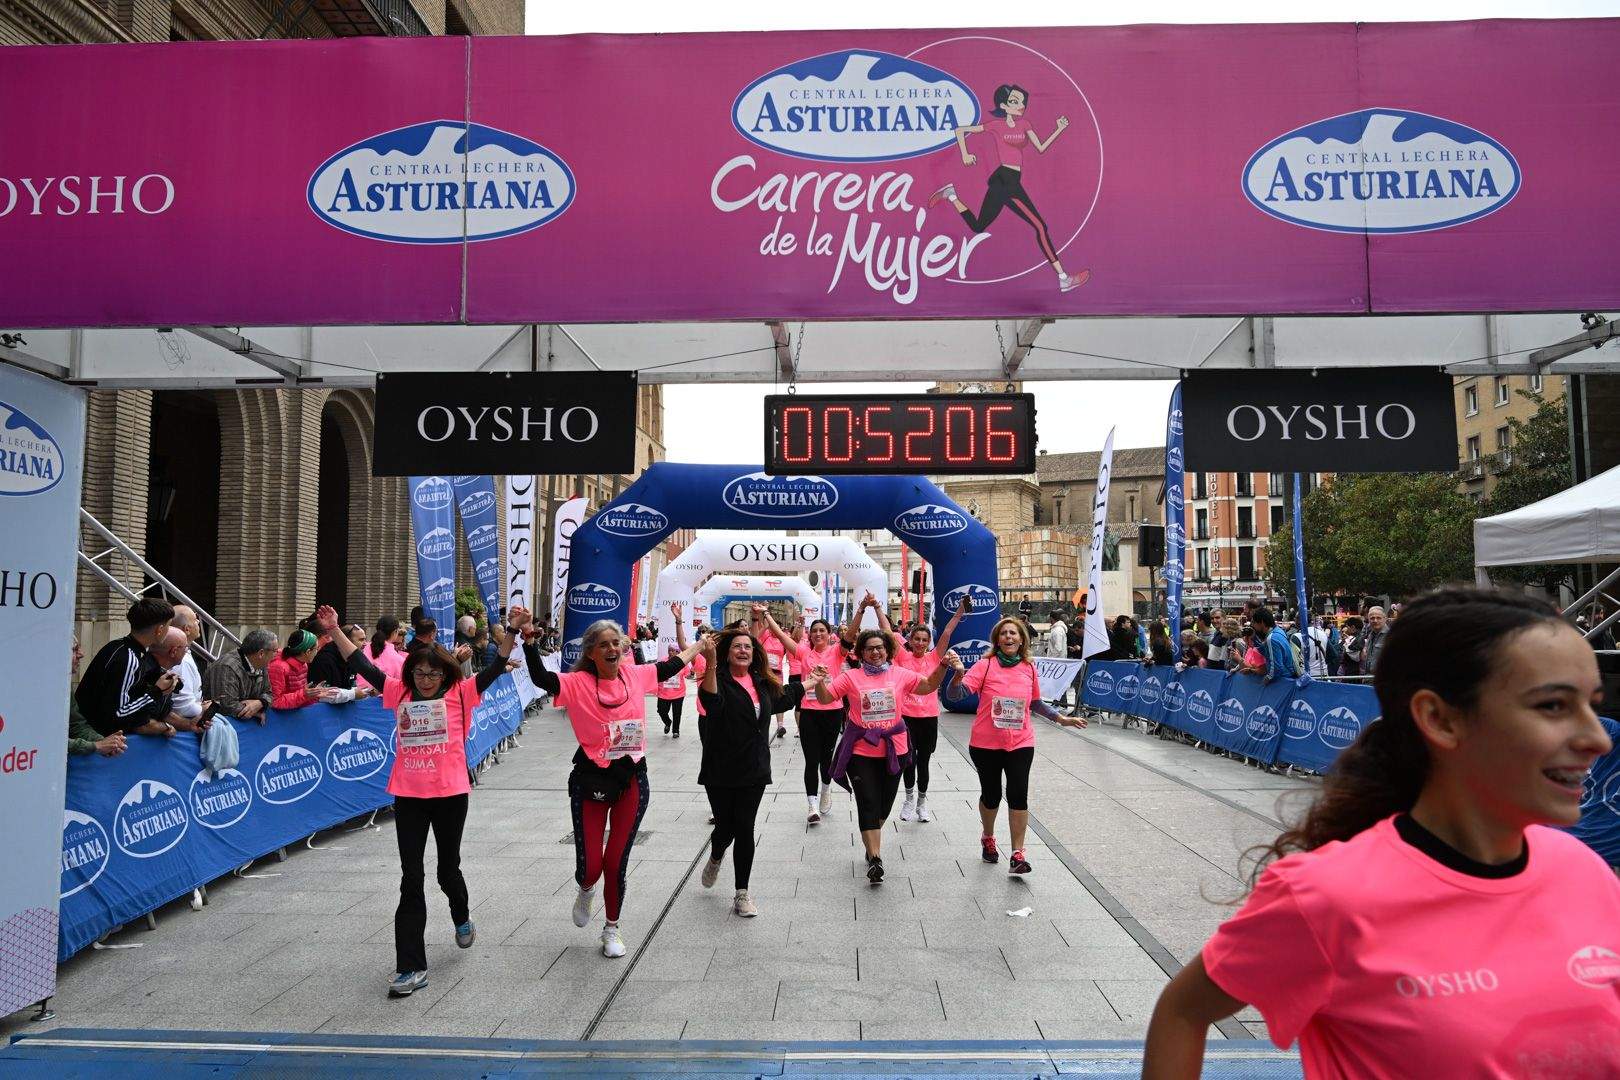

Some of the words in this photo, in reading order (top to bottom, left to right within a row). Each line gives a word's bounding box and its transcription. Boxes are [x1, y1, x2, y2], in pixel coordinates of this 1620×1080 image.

[790, 88, 866, 100] CENTRAL
[874, 88, 953, 99] LECHERA
[751, 91, 958, 132] ASTURIANA
[370, 162, 451, 176] CENTRAL
[461, 160, 547, 174] LECHERA
[1306, 151, 1391, 165] CENTRAL
[1401, 149, 1490, 163] LECHERA
[327, 166, 555, 214] ASTURIANA
[710, 155, 913, 214] Carrera
[1264, 156, 1501, 202] ASTURIANA
[759, 217, 797, 256] de
[807, 214, 833, 257] la
[828, 207, 991, 305] Mujer
[417, 405, 599, 443] OYSHO
[1226, 403, 1417, 442] OYSHO
[0, 448, 54, 480] RIANA
[731, 485, 831, 506] ASTURIANA
[600, 511, 663, 529] ASTURIANA
[900, 517, 963, 531] ASTURIANA
[729, 543, 819, 562] OYSHO
[843, 562, 872, 570] OYSHO
[0, 570, 57, 609] HO
[946, 596, 996, 608] ASRIANA
[0, 746, 37, 773] nder
[333, 747, 385, 773] ASTURIANA
[261, 764, 320, 796] ASTURIANA
[194, 786, 250, 818] ASTURIANA
[121, 806, 186, 847] ASTURIANA
[1395, 968, 1499, 999] OYSHO
